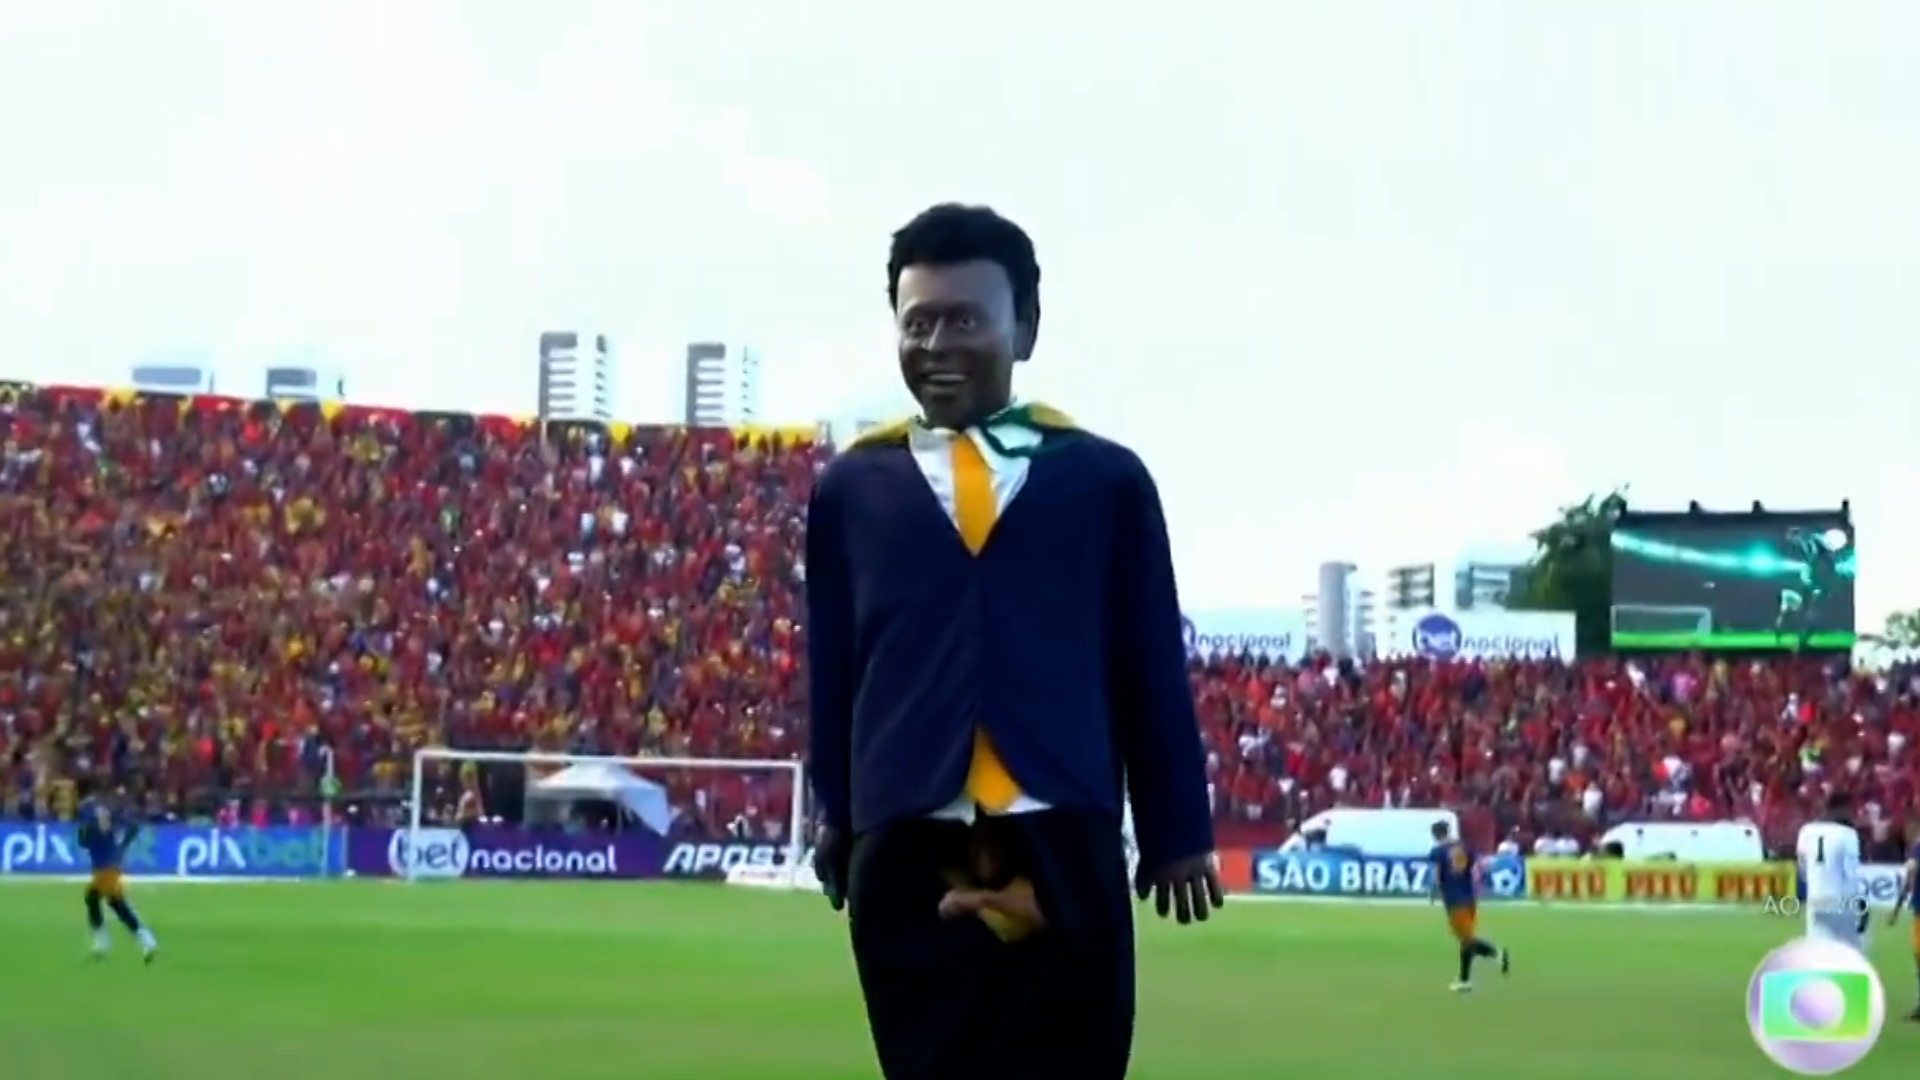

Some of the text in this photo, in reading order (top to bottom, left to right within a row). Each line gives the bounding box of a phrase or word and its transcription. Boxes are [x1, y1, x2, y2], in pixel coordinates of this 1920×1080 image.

[3, 823, 156, 871] pixt
[471, 845, 617, 872] nacional
[1257, 854, 1429, 893] SÃO BRAZ
